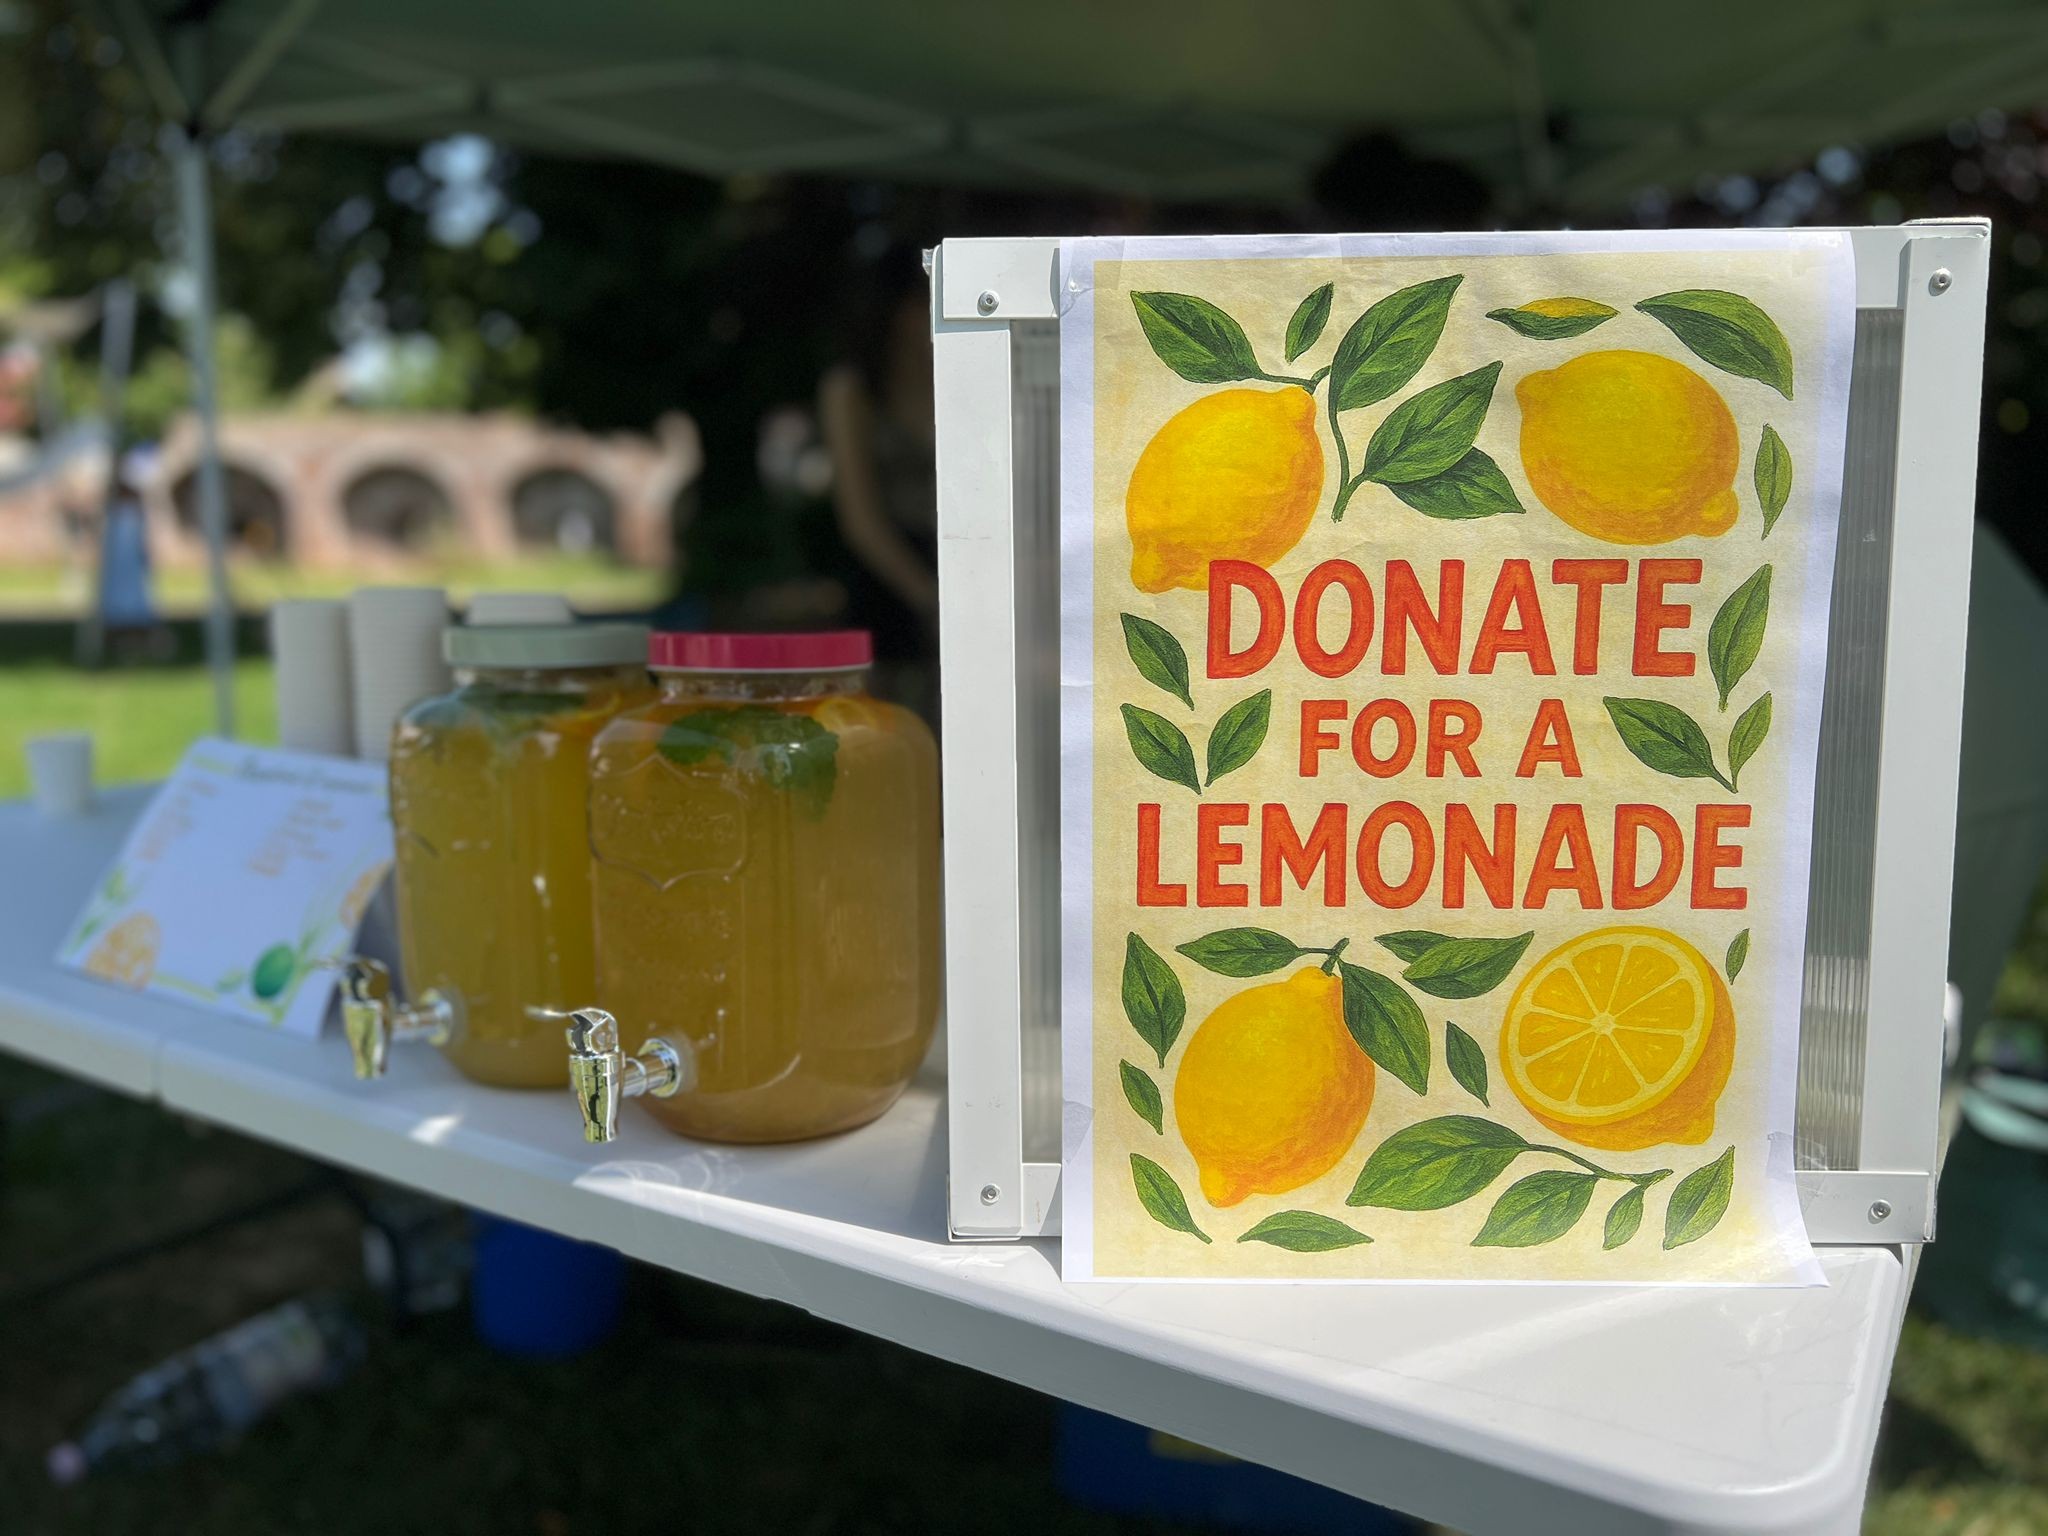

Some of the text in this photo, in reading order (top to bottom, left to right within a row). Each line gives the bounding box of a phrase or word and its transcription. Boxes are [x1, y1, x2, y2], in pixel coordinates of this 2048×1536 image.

[1207, 558, 1703, 678] DONATE
[1299, 699, 1582, 778] FOR A
[1137, 801, 1751, 909] LEMONADE
